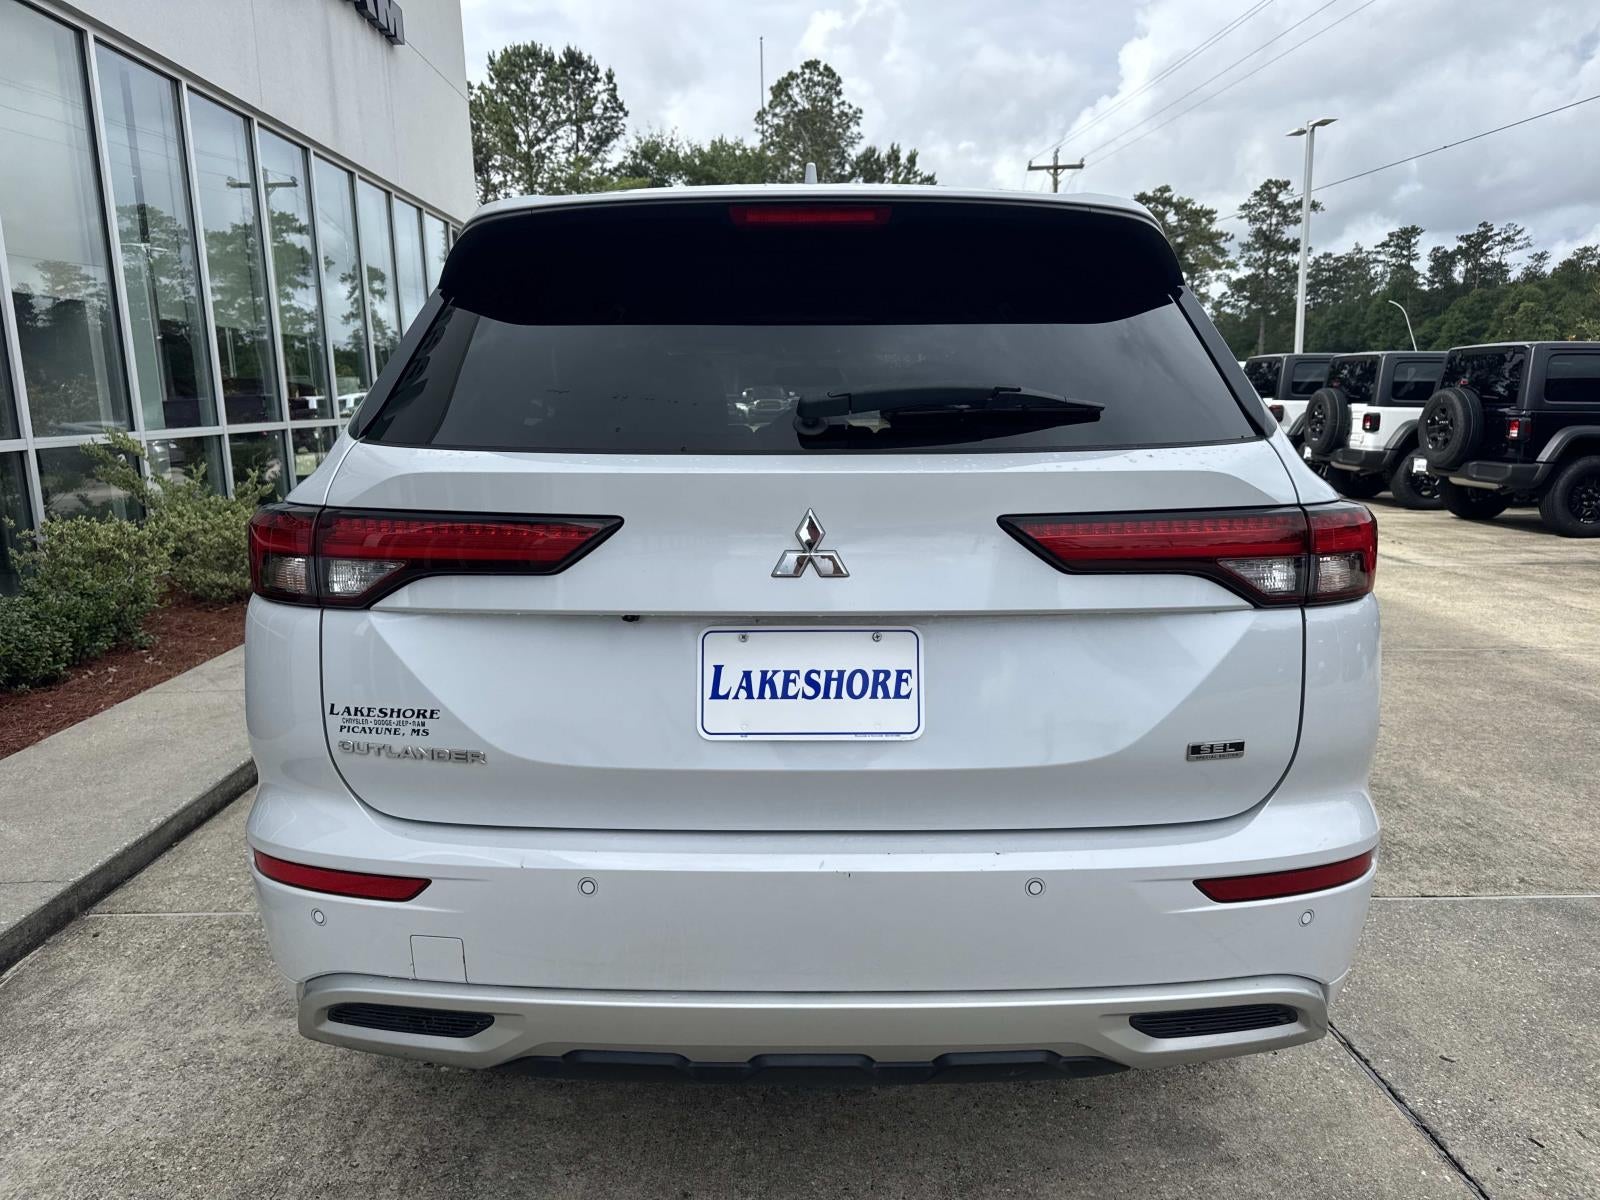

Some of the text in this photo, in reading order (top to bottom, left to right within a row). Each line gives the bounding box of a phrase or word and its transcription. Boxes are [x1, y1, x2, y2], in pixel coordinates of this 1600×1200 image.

[708, 664, 913, 700] LAKESHORE
[329, 703, 441, 720] LAKESHORE
[341, 717, 369, 725] CHRYSLER
[339, 725, 430, 737] PICAYUNE, MS
[338, 740, 488, 765] OUTLANDER
[1200, 743, 1236, 754] SEL
